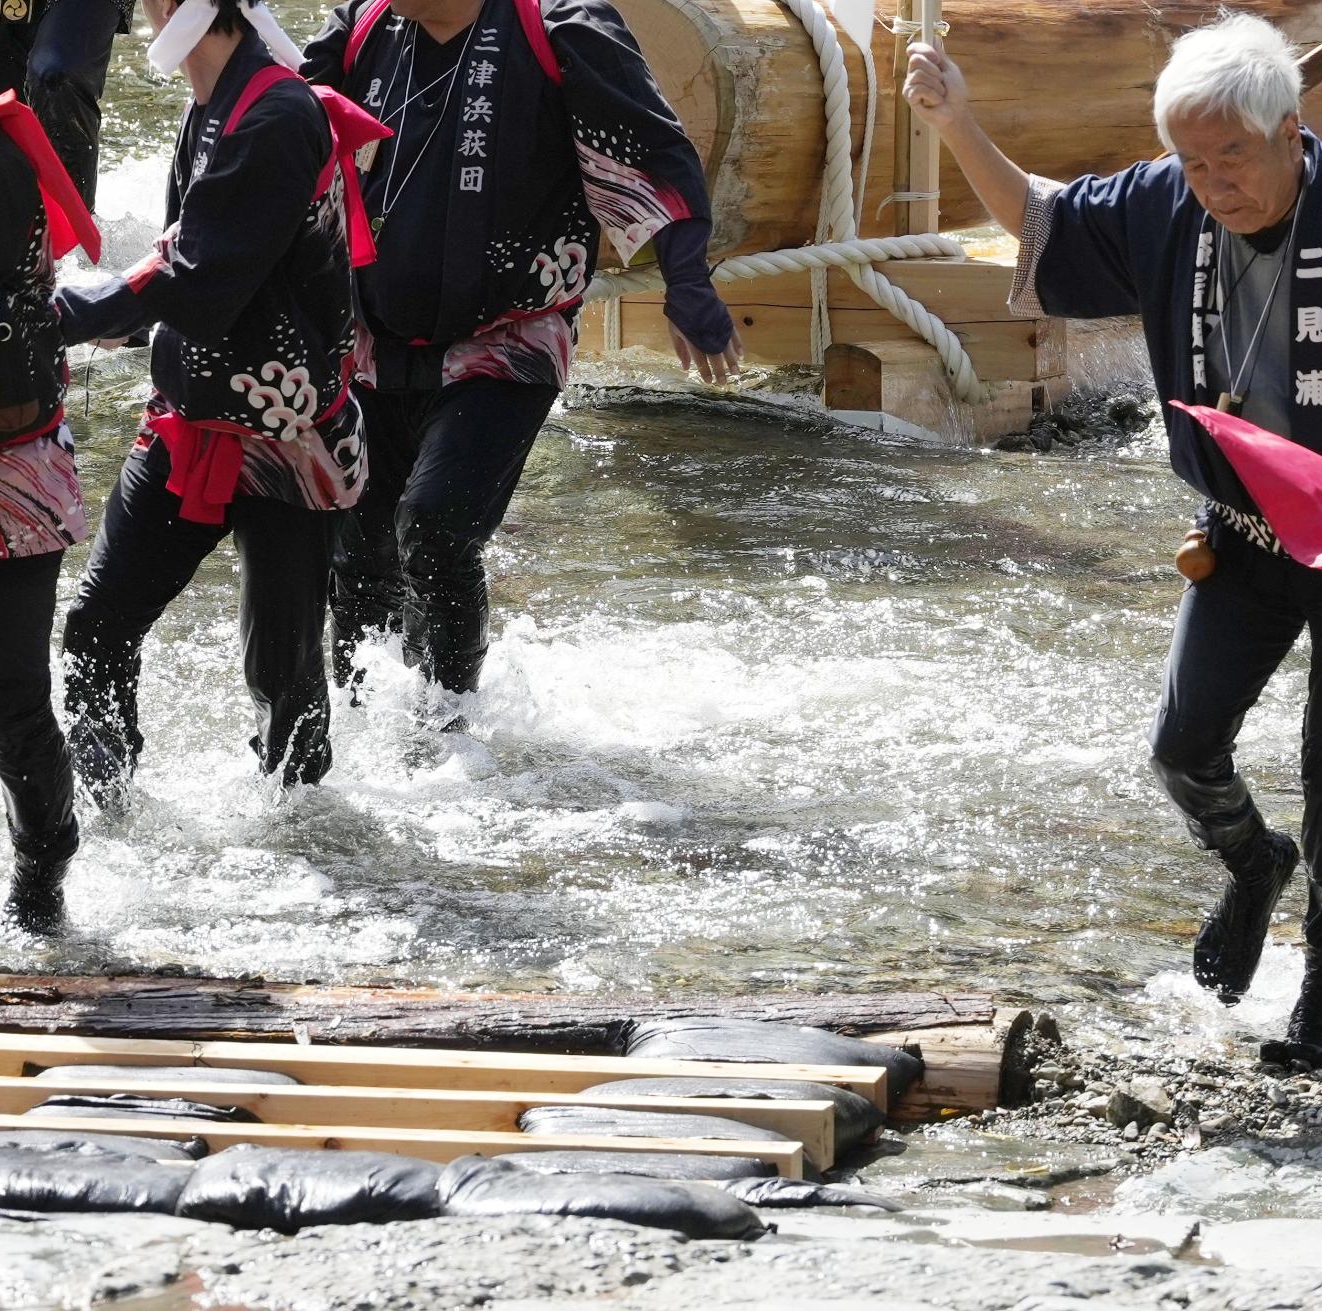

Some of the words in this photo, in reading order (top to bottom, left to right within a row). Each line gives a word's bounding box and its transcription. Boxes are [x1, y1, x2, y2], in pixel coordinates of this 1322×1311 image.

[456, 28, 502, 194] 三津浜荻団
